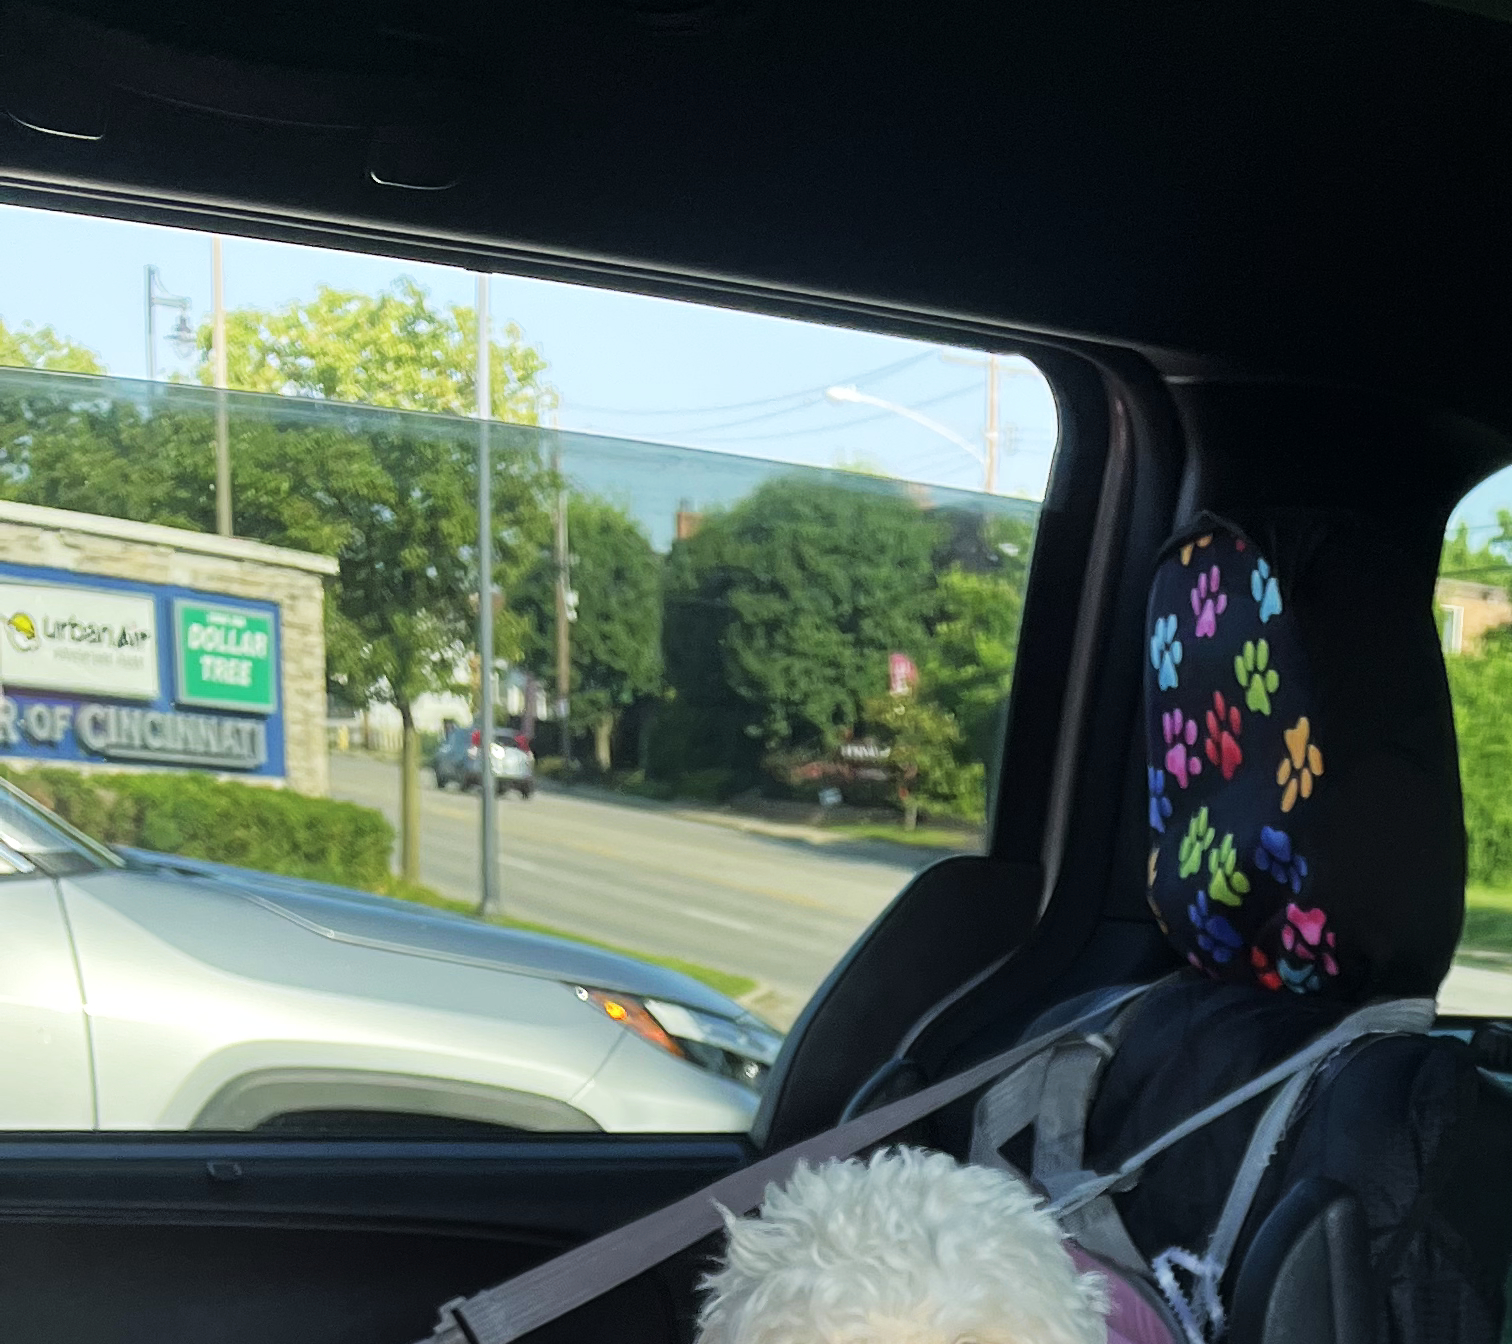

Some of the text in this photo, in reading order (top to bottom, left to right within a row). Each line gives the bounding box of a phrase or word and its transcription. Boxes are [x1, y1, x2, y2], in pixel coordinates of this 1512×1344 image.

[187, 621, 268, 660] DOLLAR
[199, 655, 252, 687] TREE
[24, 702, 73, 743] OF
